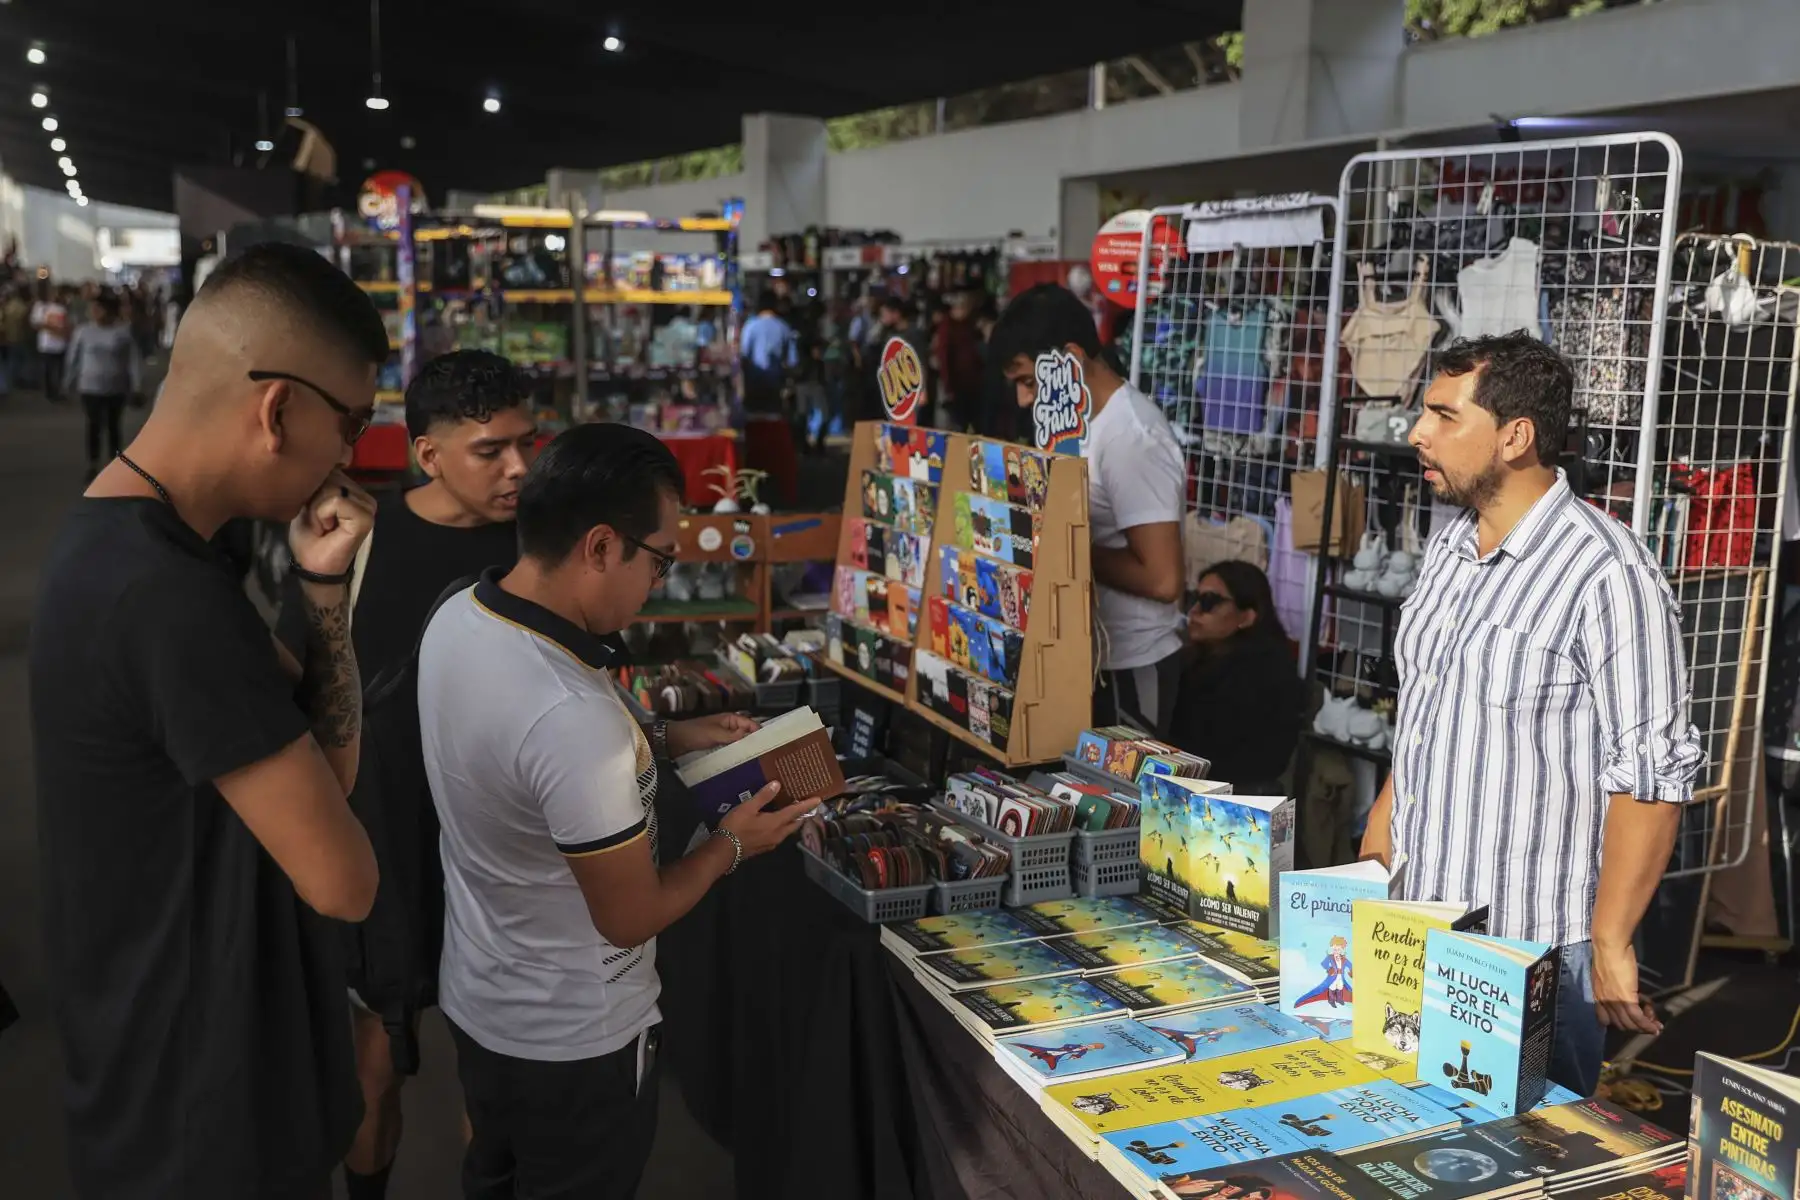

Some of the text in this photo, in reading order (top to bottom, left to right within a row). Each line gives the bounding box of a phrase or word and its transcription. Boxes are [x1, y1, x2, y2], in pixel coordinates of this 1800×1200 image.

[881, 347, 921, 408] UNO
[1038, 357, 1081, 403] Fun
[1036, 401, 1078, 446] Fans
[1200, 897, 1220, 910] ¿CÓMO
[1222, 902, 1231, 913] SER
[1234, 905, 1260, 922] VALIENTE?
[1291, 892, 1352, 922] El princi
[1375, 948, 1390, 960] no
[1395, 953, 1408, 966] es
[1447, 947, 1464, 959] JUAN
[1466, 954, 1488, 968] PABLO
[1386, 964, 1419, 990] Lobos
[1437, 963, 1510, 1006] MI LUCHA
[1446, 985, 1499, 1019] POR EL
[1450, 1001, 1493, 1034] ÉXITO
[1296, 1050, 1346, 1076] Rendirse
[1158, 1074, 1205, 1103] Rendirse
[1722, 1076, 1741, 1092] LENIN
[1741, 1085, 1766, 1104] SOLANO
[1350, 1097, 1381, 1112] POR
[1378, 1112, 1396, 1122] EL
[1359, 1089, 1380, 1098] MI
[1376, 1098, 1420, 1122] LUCHA
[1720, 1096, 1784, 1141] ASESINATO
[1206, 1126, 1236, 1141] POR
[1228, 1142, 1248, 1152] EL
[1216, 1118, 1237, 1127] MI
[1230, 1127, 1272, 1154] LUCHA
[1731, 1122, 1769, 1157] ENTRE
[1303, 1155, 1348, 1185] LOS DÍAS DE
[1356, 1162, 1383, 1178] BAJO
[1377, 1174, 1398, 1187] LA
[1720, 1138, 1776, 1180] PINTURAS
[1377, 1161, 1433, 1193] SACRIFICIOS
